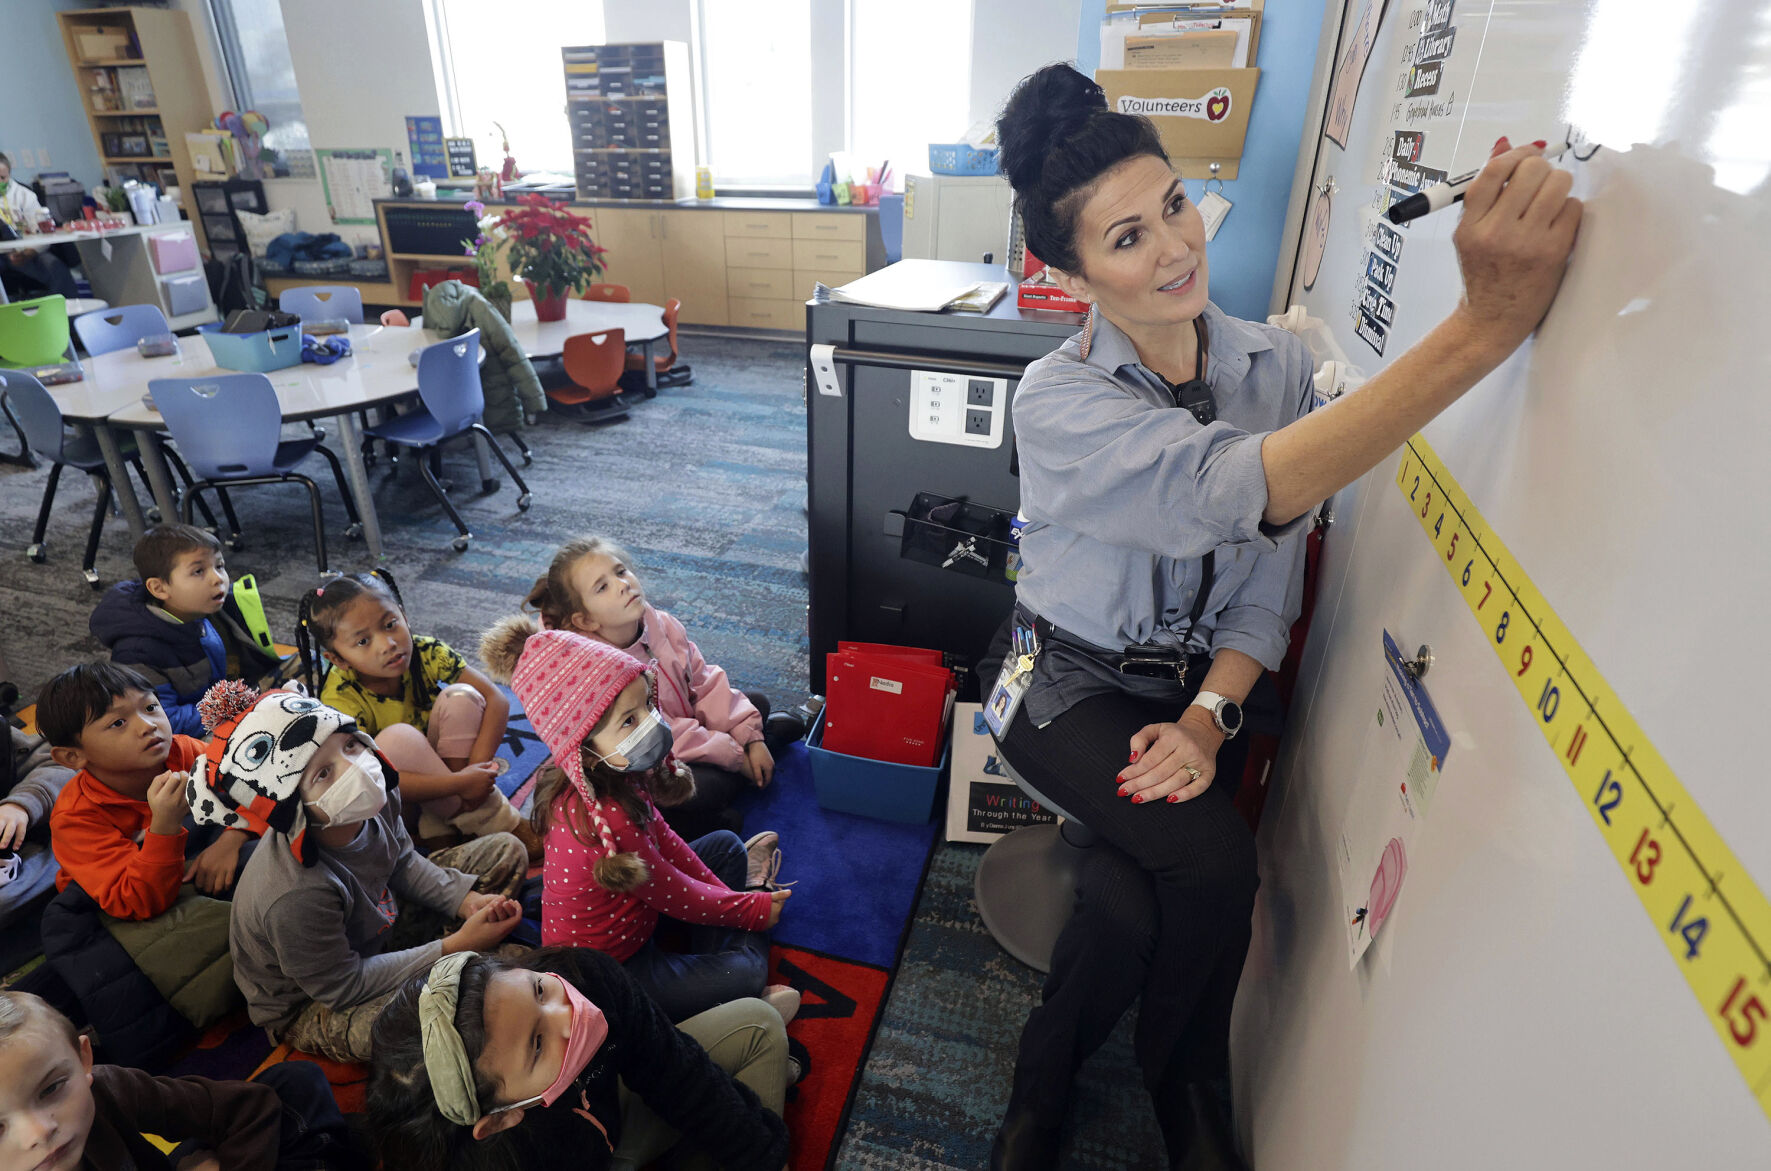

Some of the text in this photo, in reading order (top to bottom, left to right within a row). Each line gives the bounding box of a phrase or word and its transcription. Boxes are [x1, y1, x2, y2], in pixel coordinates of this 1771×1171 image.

[1423, 35, 1452, 59] Library
[1413, 68, 1439, 90] Recess
[1121, 99, 1202, 113] Volunteers
[1397, 137, 1415, 161] Daily
[1392, 233, 1400, 260] Up
[1385, 265, 1393, 291] Up
[1359, 316, 1385, 352] Dismissal
[1402, 461, 1768, 1049] 1 2 3 4 5 6 7 8 9 10 11 12 13 14 15
[973, 808, 1052, 822] Through the Year
[986, 794, 1040, 812] Writing
